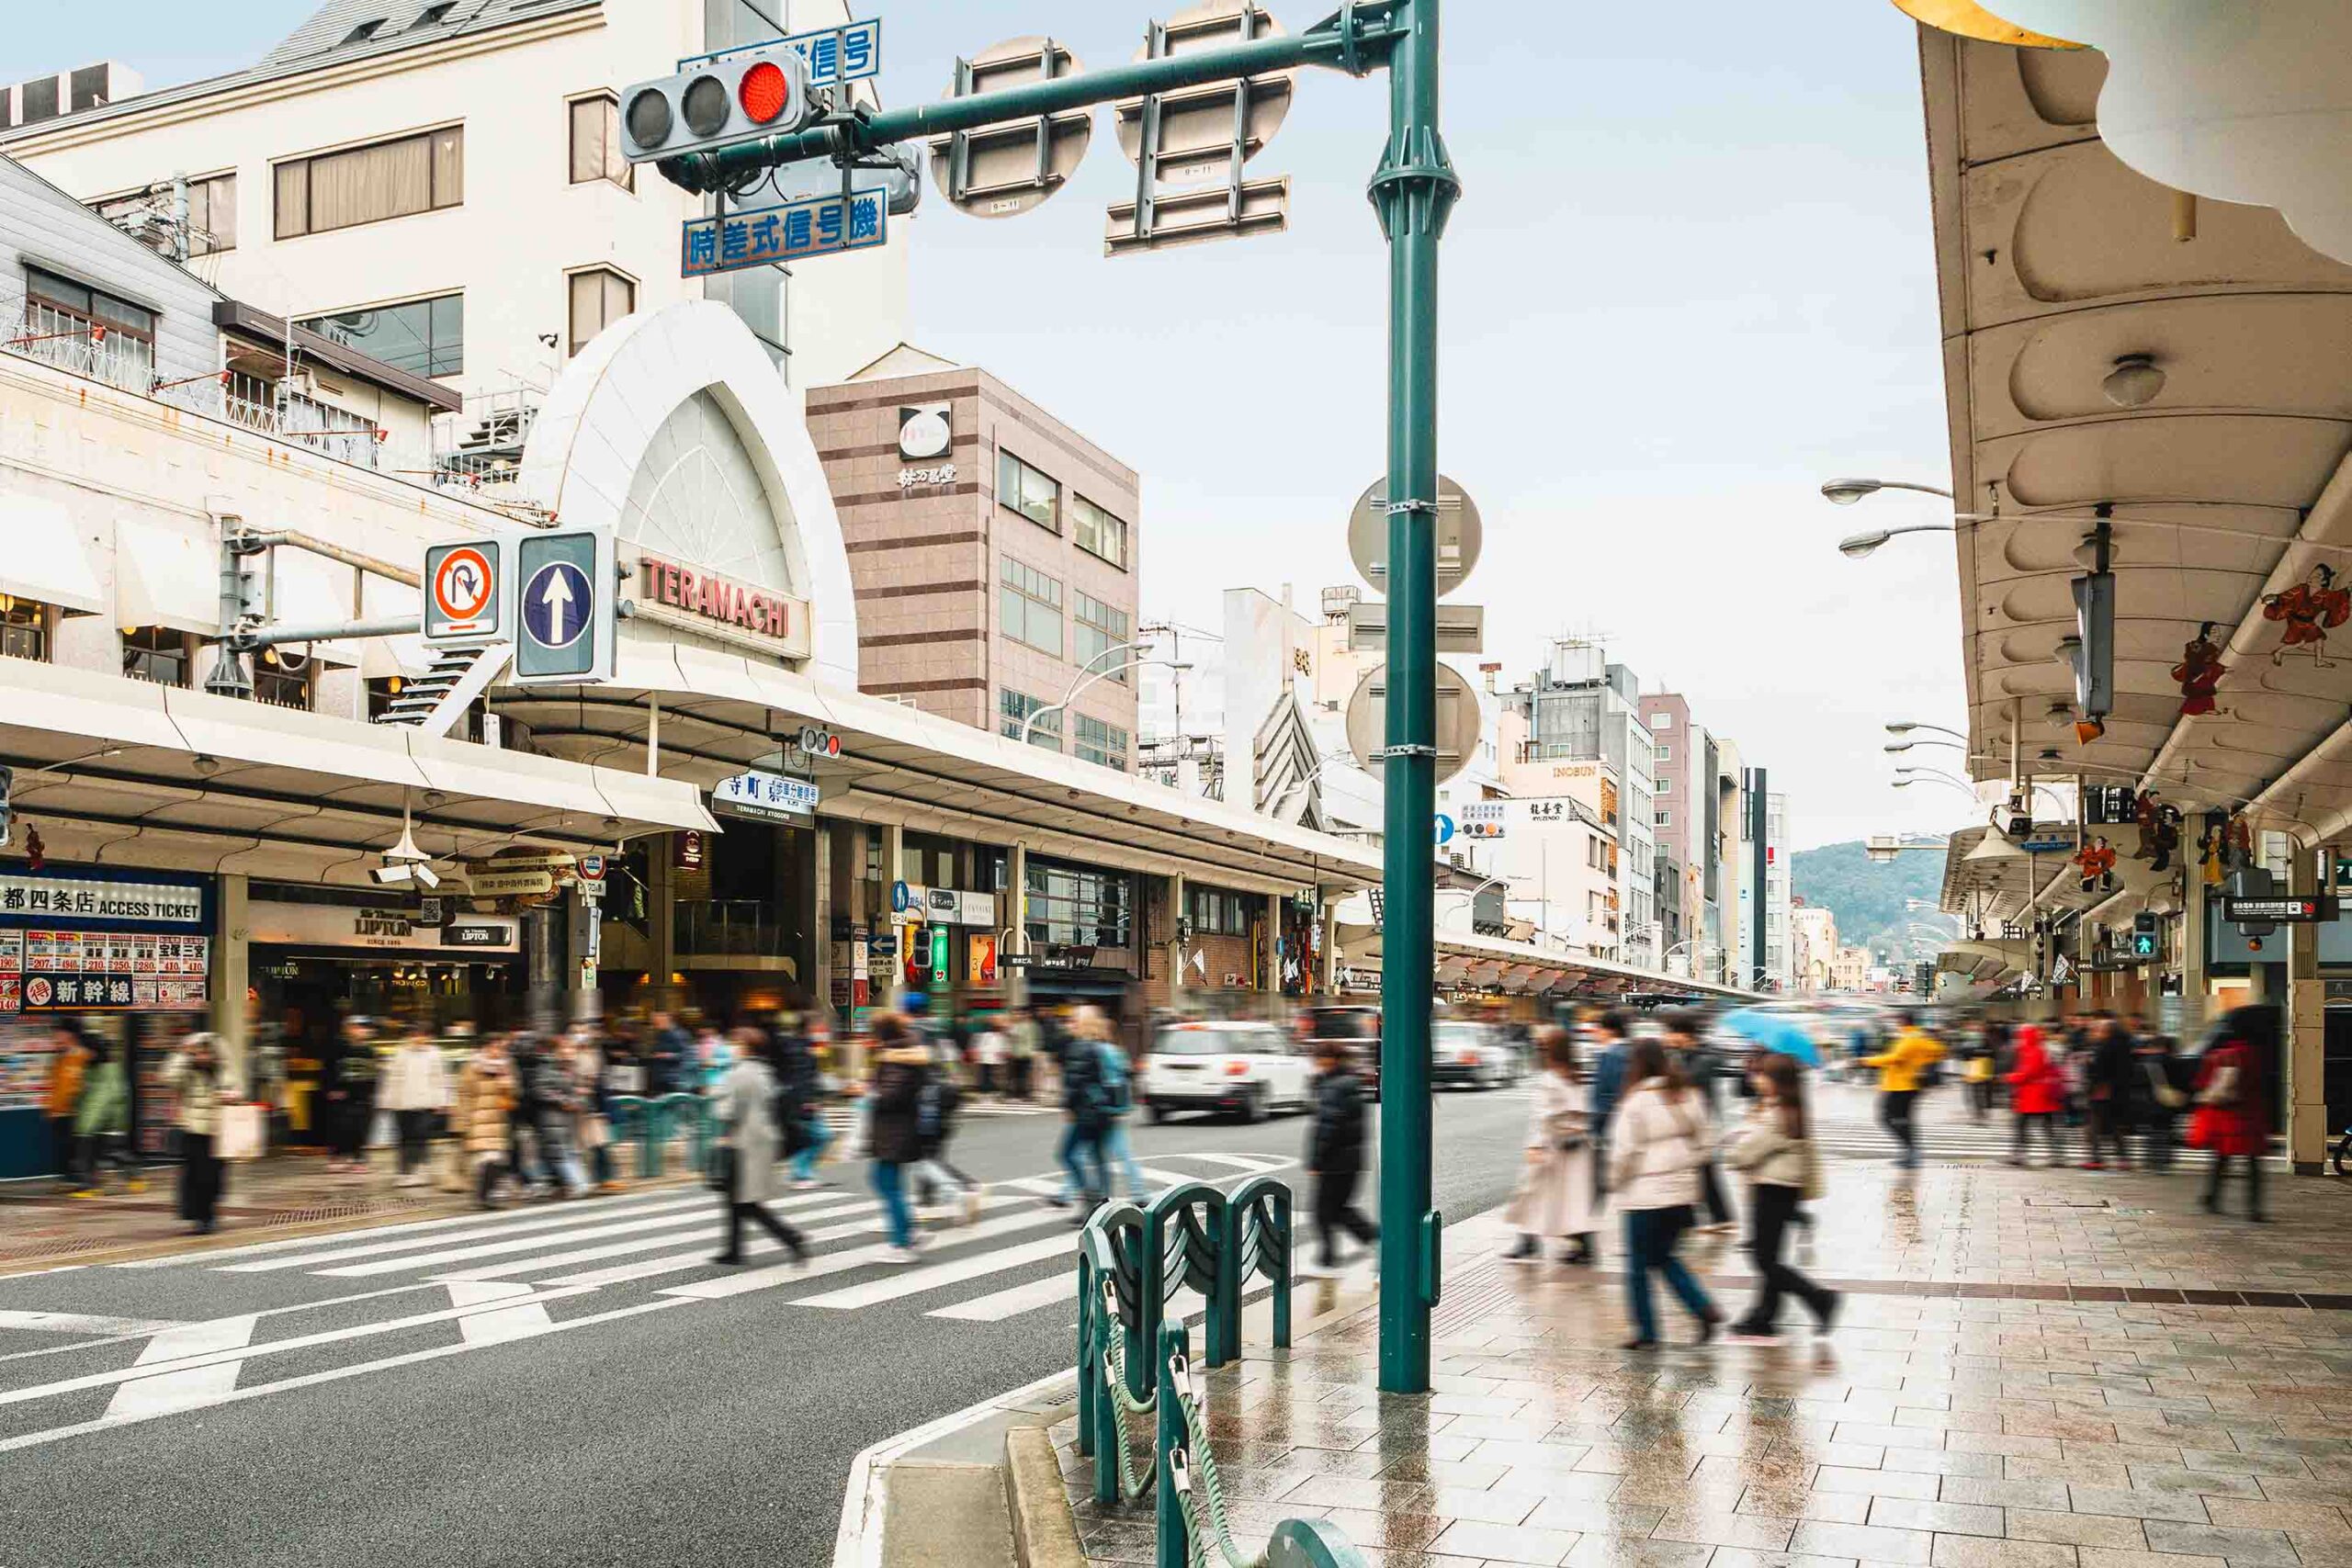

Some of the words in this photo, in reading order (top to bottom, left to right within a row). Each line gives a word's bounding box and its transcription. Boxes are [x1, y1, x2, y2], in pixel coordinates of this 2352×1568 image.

[691, 197, 876, 265] 時差式信号機
[640, 557, 789, 638] TERAMACHI
[1553, 765, 1597, 778] INOBUN
[728, 776, 799, 807] 寺町京
[4, 887, 96, 913] 都四条店
[98, 900, 150, 917] ACCESS
[153, 903, 198, 919] TICKET
[354, 919, 413, 937] LIPTON
[461, 932, 489, 941] LIPTON
[159, 944, 181, 957] 宝塚
[183, 945, 204, 958] 三宮
[34, 959, 51, 968] 207
[113, 961, 130, 970] 250
[29, 979, 51, 1002] 得
[57, 979, 130, 1003] 新幹線
